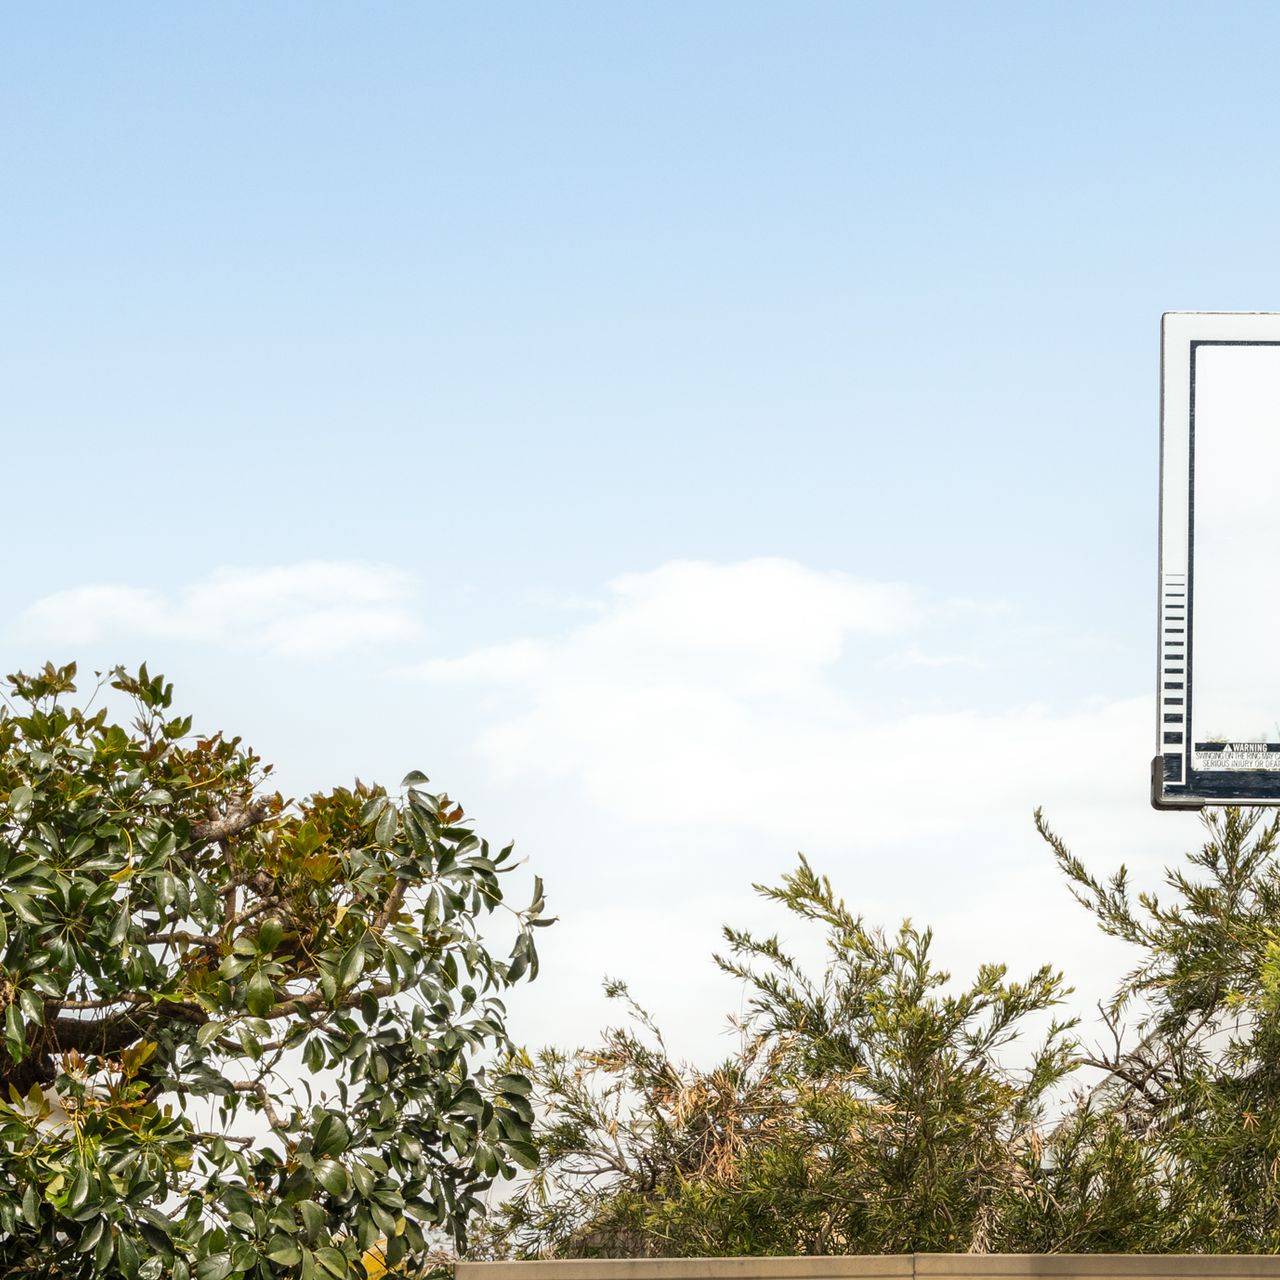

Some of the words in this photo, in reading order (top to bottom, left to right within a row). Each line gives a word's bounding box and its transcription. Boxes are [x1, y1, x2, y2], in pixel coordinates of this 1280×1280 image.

[1232, 743, 1268, 752] WARNING
[1235, 752, 1245, 760] THE
[1246, 752, 1261, 760] RING
[1262, 752, 1274, 760] MAY
[1202, 760, 1230, 768] SERIOUS
[1231, 760, 1253, 768] INJURY
[1255, 760, 1264, 768] OR
